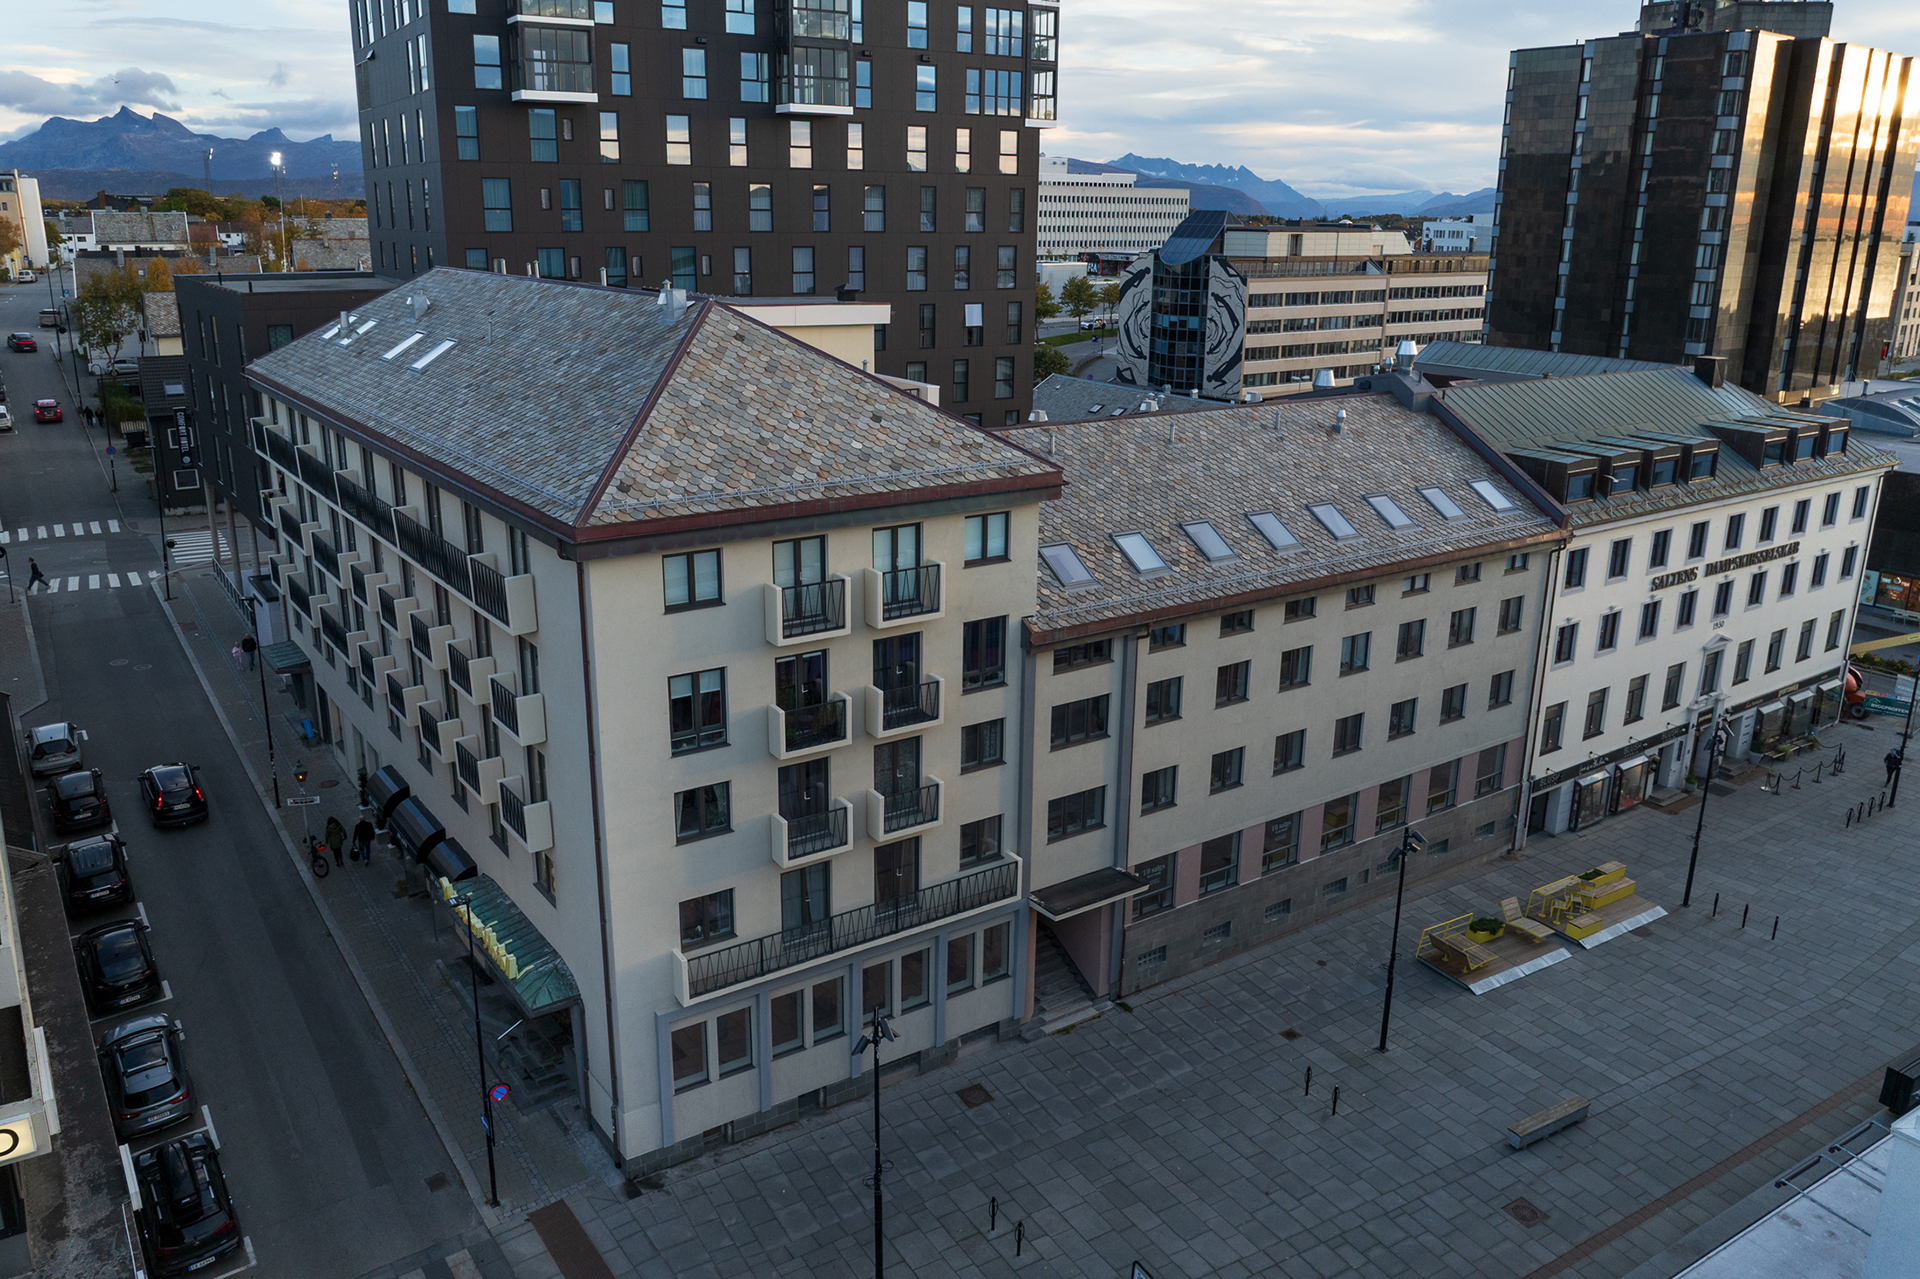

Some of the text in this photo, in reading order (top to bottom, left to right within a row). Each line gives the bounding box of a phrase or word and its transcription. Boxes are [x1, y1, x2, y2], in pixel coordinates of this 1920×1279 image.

[176, 411, 189, 453] COMFORT HOTEL
[1650, 566, 1699, 592] SALTENS
[1870, 702, 1909, 714] BYGGPROFFEN
[1623, 741, 1643, 755] BLUSH
[1539, 773, 1561, 787] BLUSH
